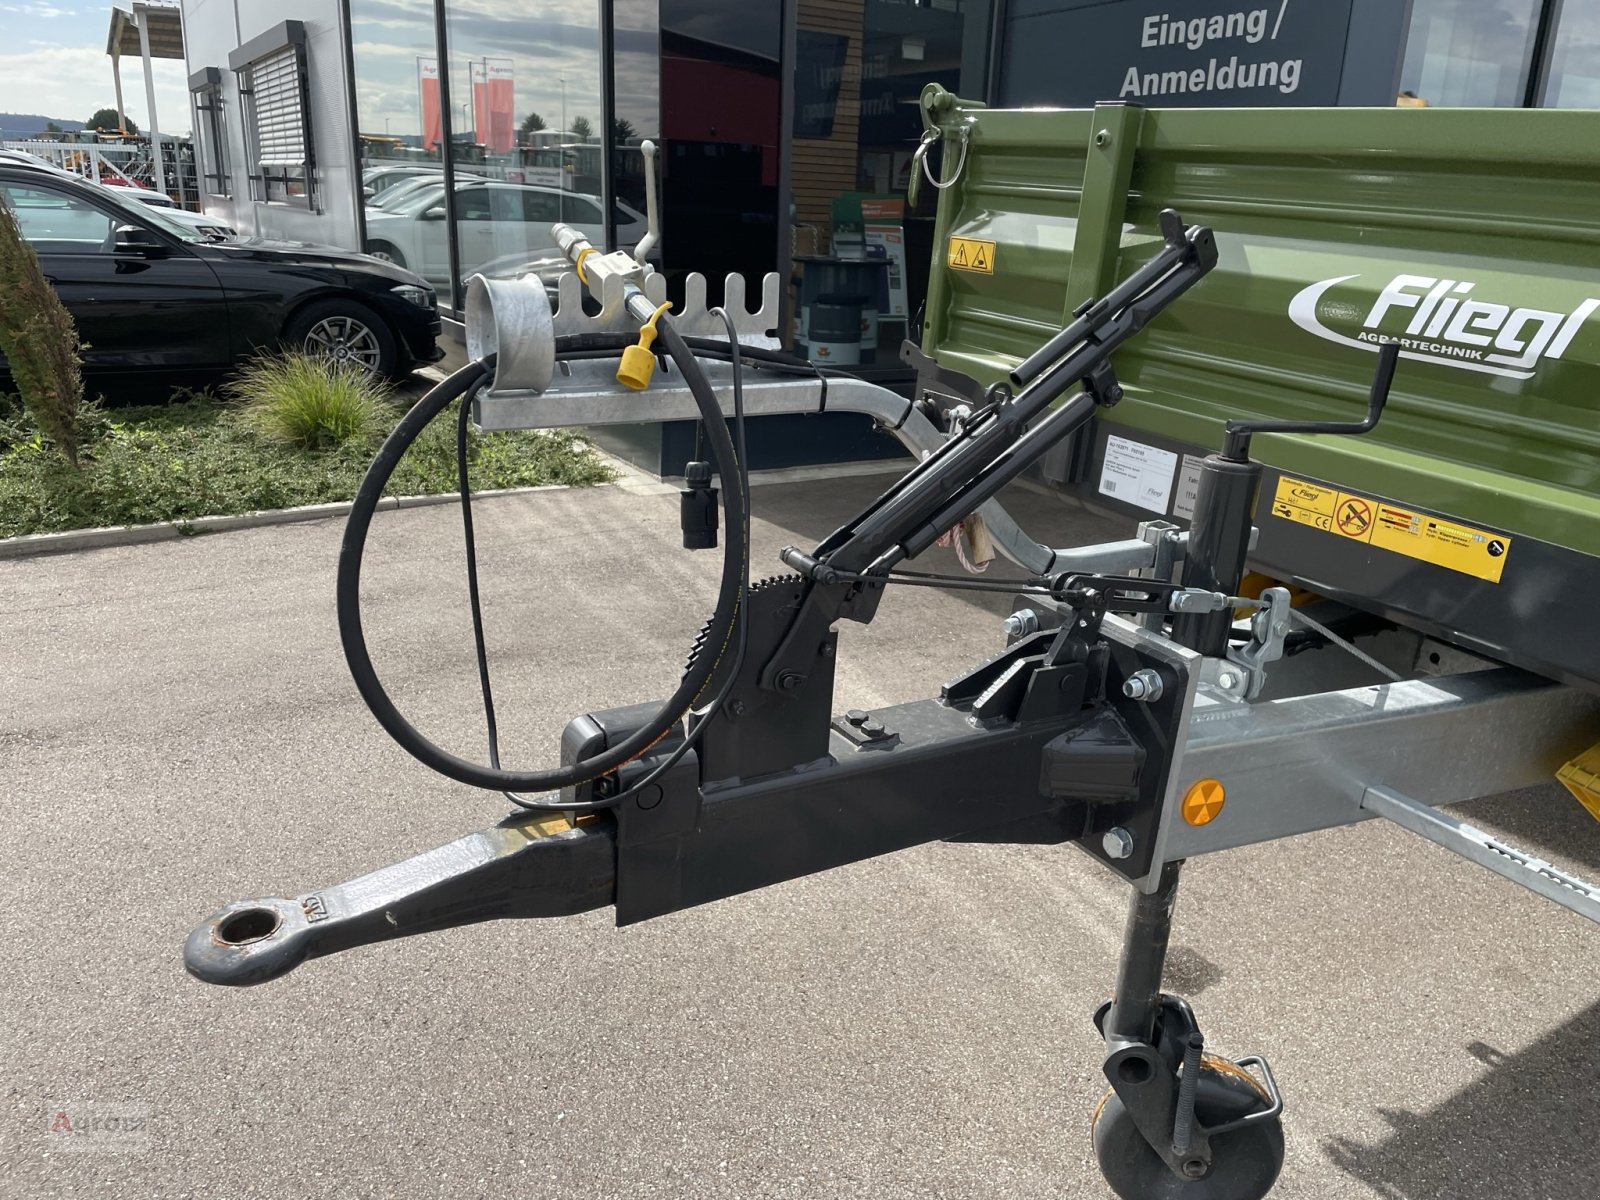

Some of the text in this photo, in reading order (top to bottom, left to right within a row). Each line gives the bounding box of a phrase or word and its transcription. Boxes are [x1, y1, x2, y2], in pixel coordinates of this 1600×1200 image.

[1141, 9, 1268, 51] Eingang
[1119, 56, 1303, 97] Anmeldung
[1363, 274, 1600, 370] Fliegl
[1299, 489, 1319, 502] Fliegl
